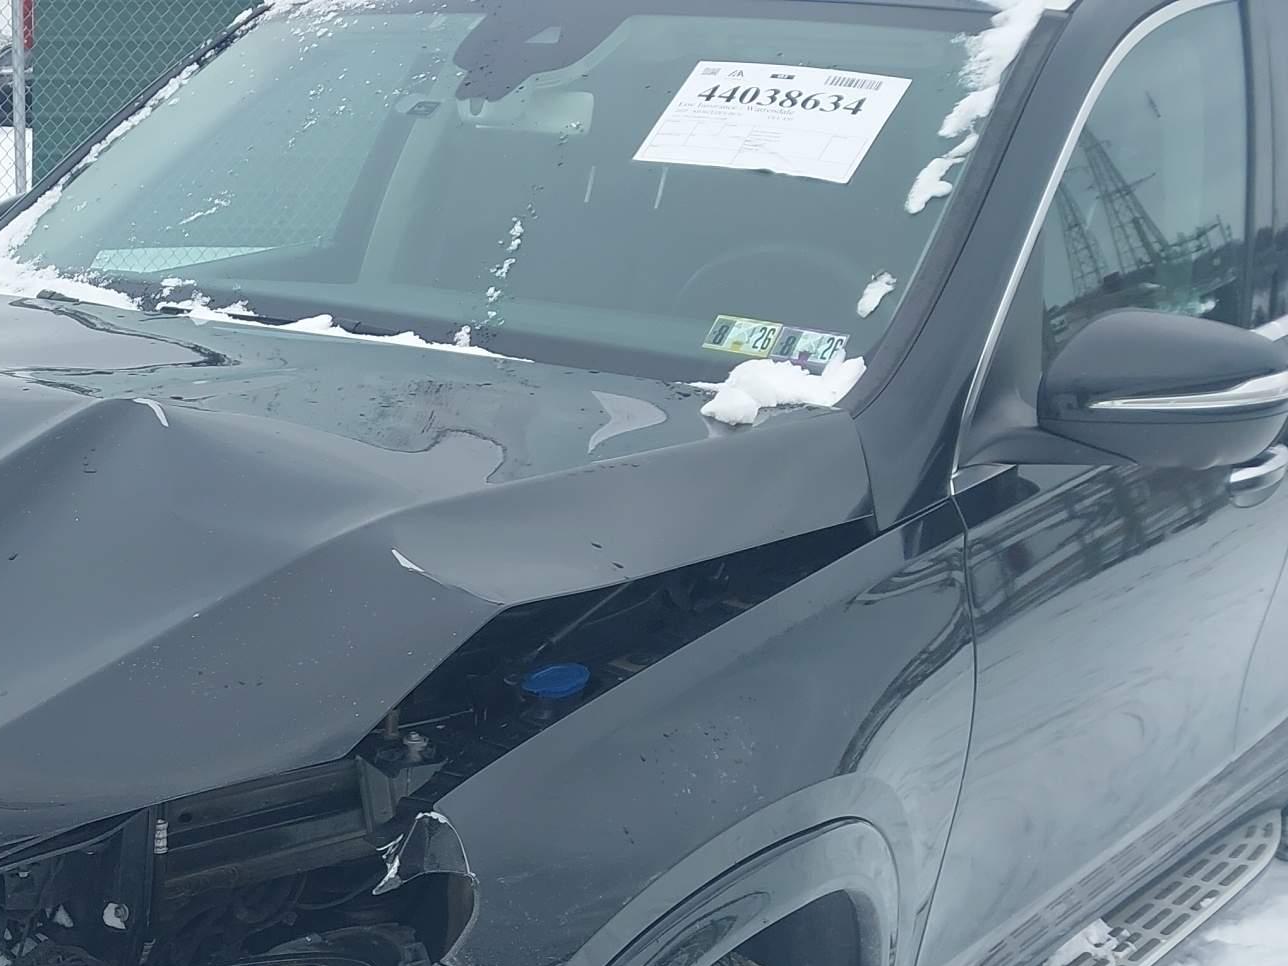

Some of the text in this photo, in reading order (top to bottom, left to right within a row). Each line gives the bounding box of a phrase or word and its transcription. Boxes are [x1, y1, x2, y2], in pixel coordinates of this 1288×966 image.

[697, 84, 867, 115] 44038634
[746, 105, 795, 115] Warrendale
[713, 325, 776, 350] 8 26
[780, 335, 797, 356] 8
